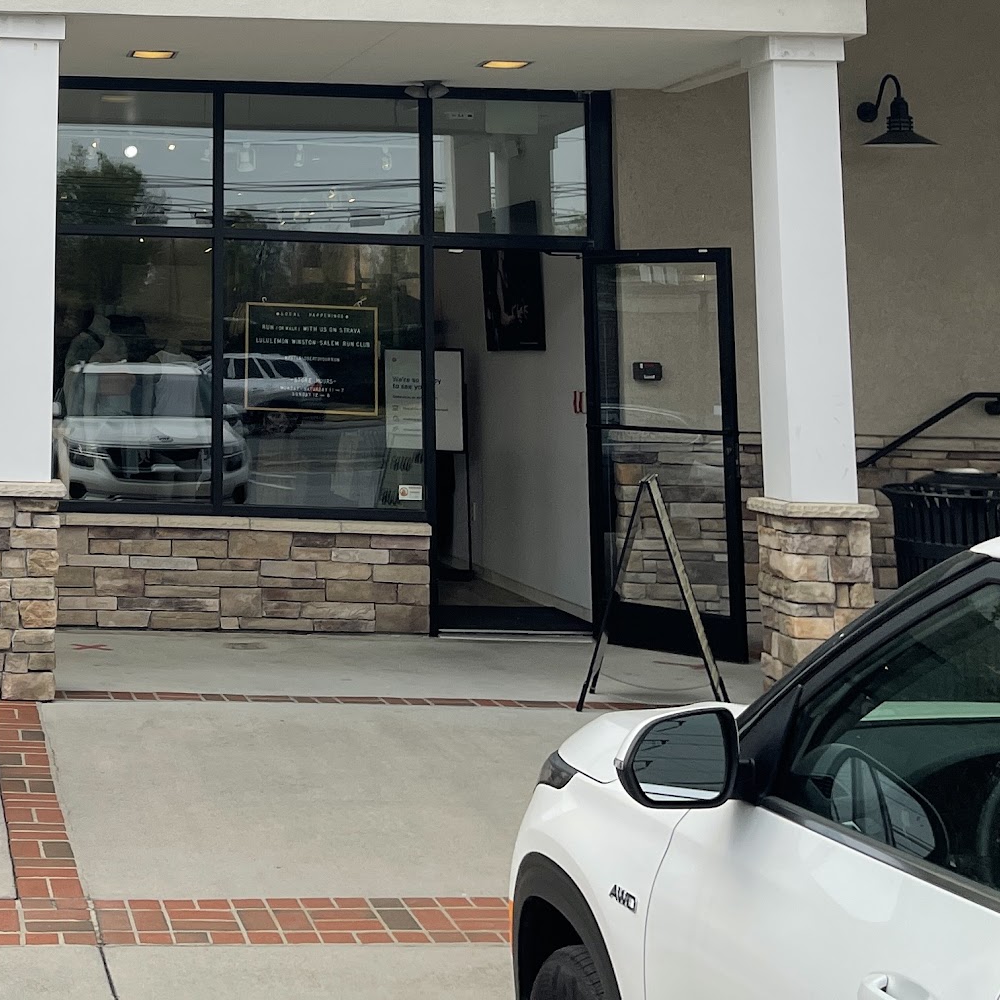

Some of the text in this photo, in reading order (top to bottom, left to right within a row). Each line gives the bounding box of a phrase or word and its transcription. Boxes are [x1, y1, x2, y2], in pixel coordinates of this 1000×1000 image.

[261, 323, 274, 331] RUN
[255, 337, 289, 345] LULULEMON
[608, 884, 638, 914] AWD
